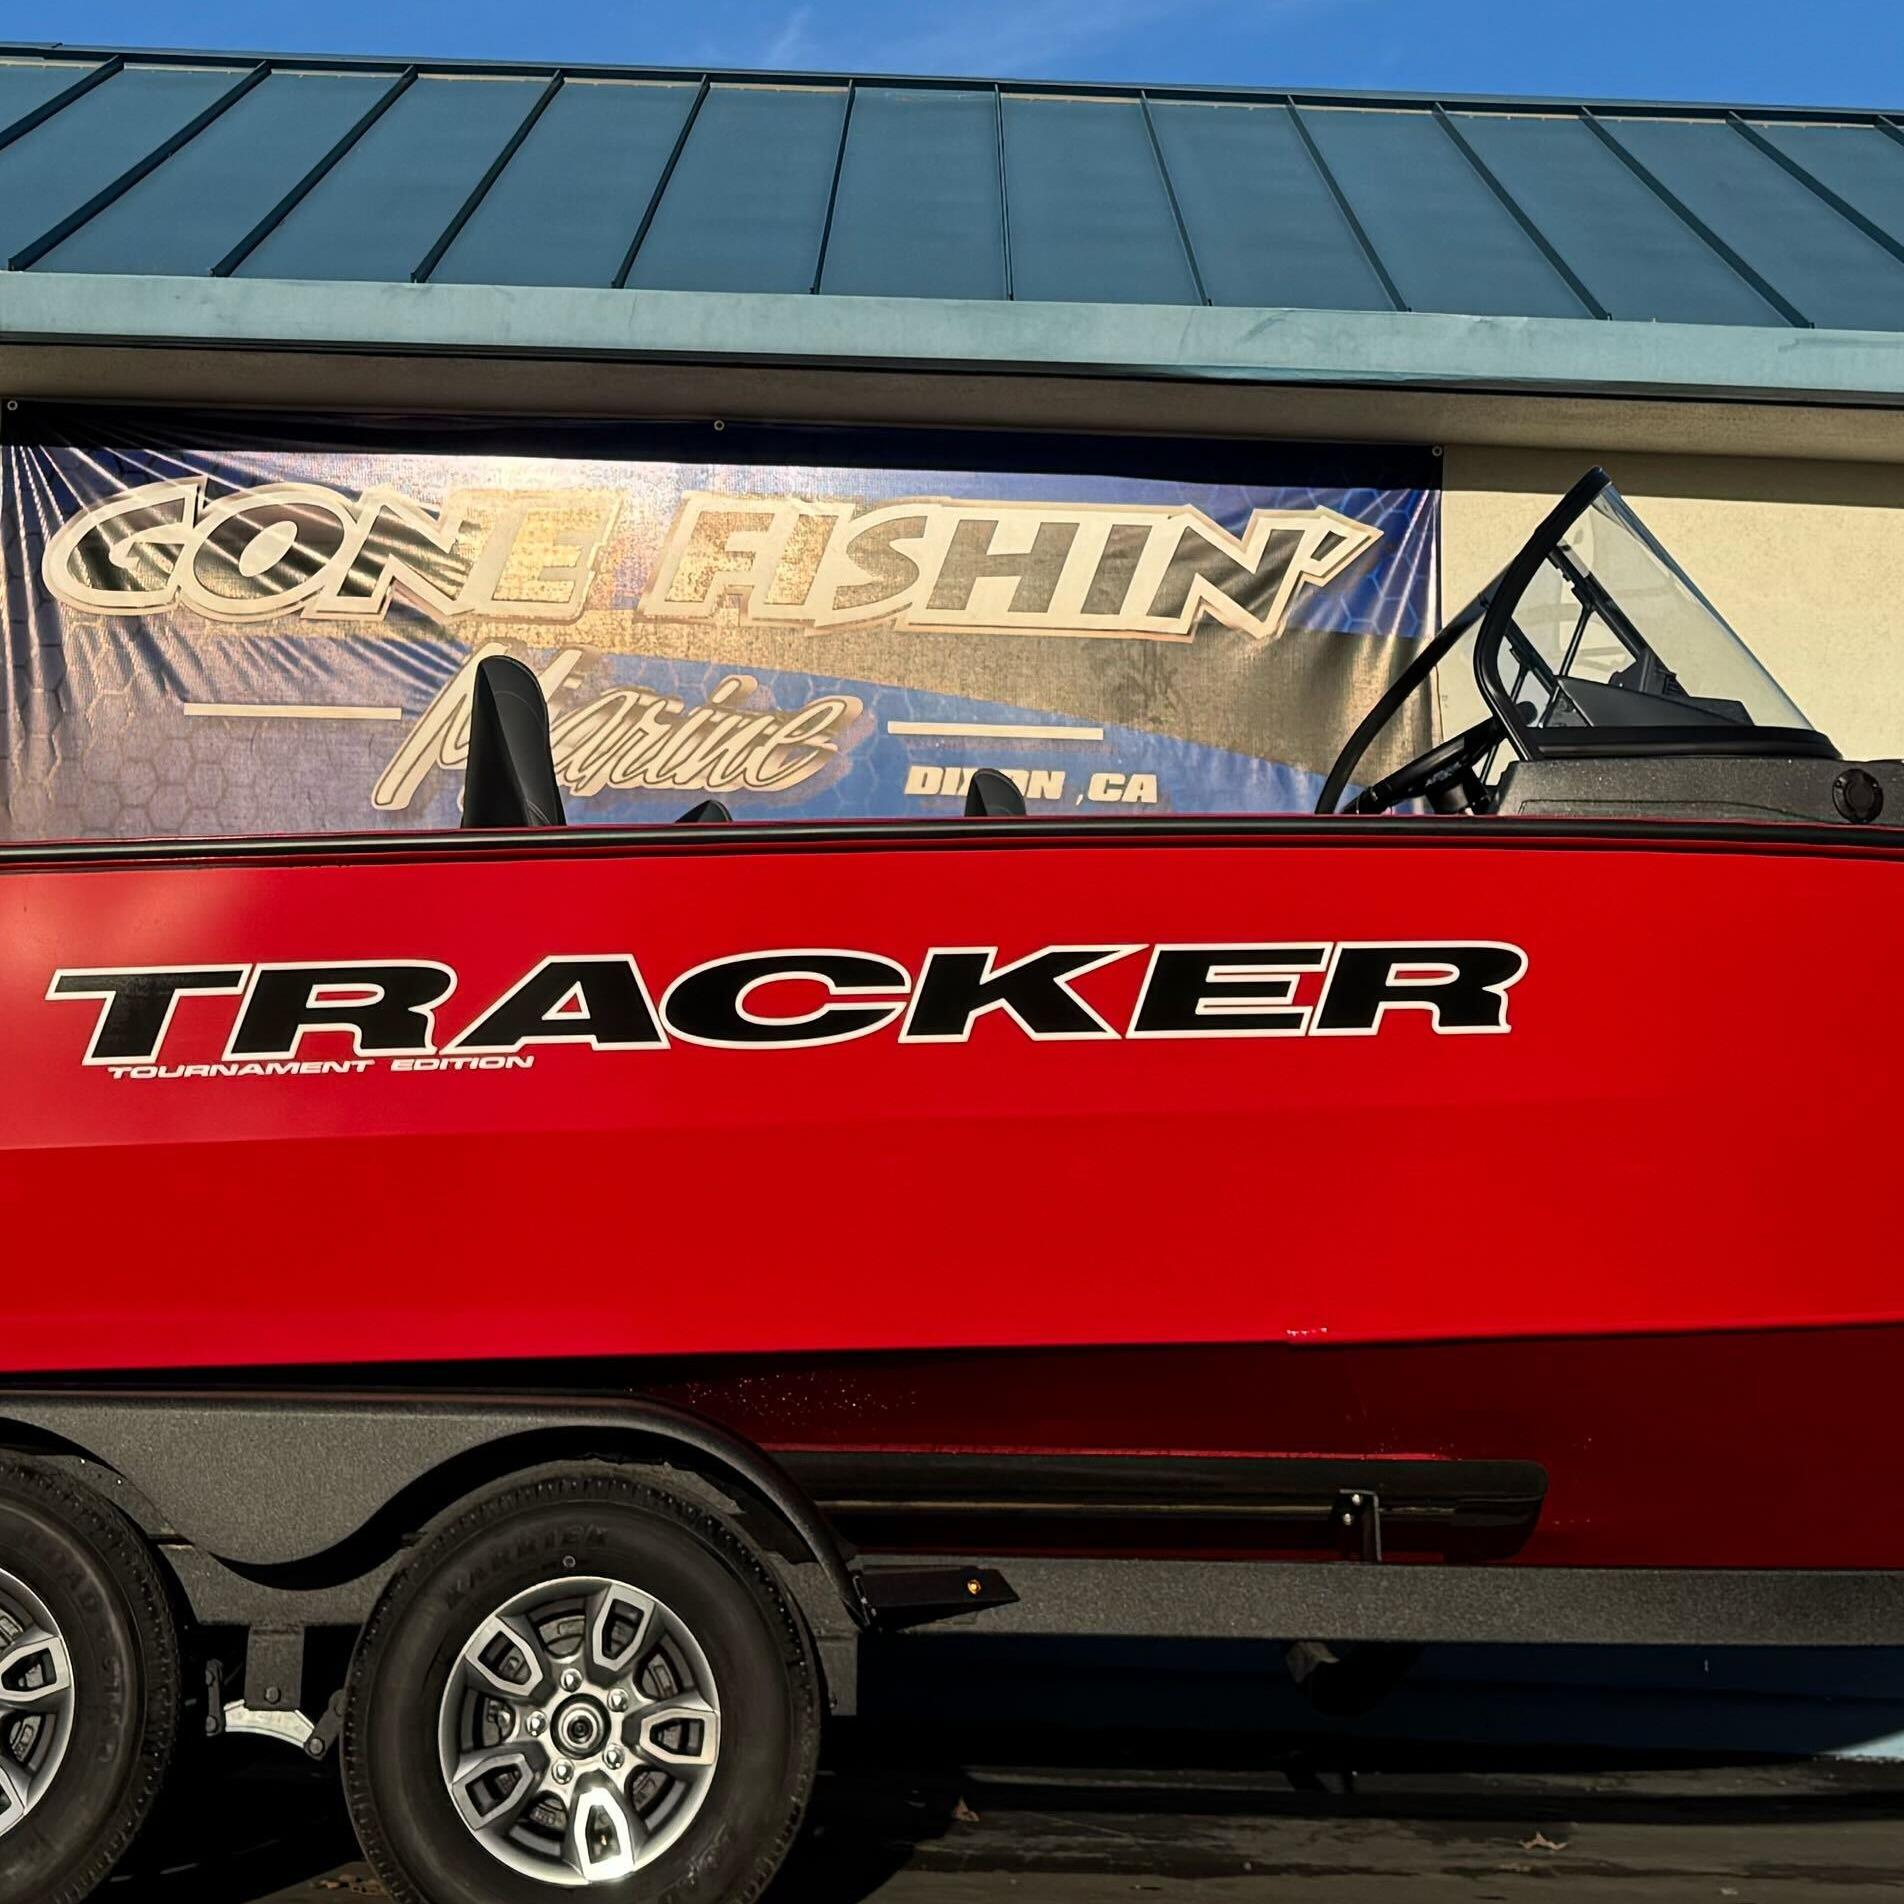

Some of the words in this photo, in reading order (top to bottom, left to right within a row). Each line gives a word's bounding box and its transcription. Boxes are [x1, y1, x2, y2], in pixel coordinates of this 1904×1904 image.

[43, 478, 622, 621] GONE
[45, 941, 1529, 1065] TRACKER
[108, 1059, 375, 1079] TOURNAMENT
[390, 1055, 534, 1072] EDITION
